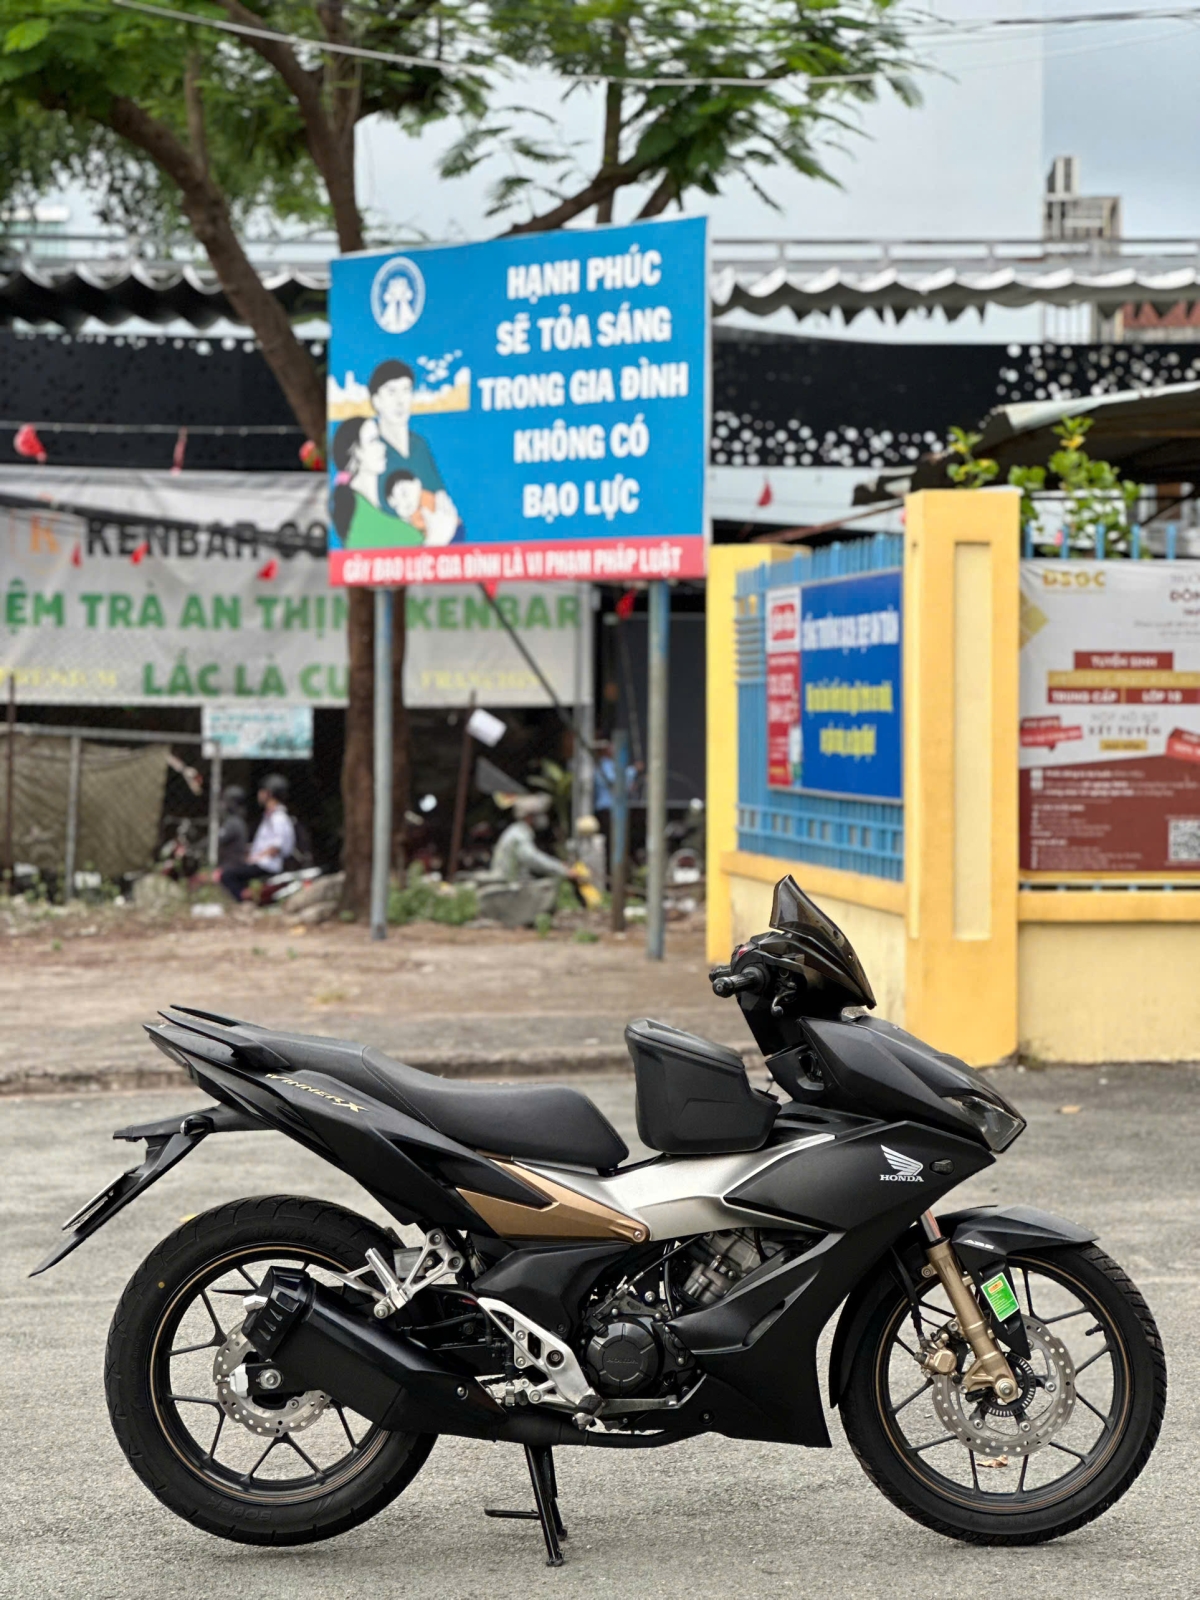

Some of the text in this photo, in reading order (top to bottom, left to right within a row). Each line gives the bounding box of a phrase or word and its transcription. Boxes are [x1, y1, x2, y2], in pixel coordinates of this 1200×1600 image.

[507, 243, 662, 304] HẠNH PHÚC
[496, 302, 673, 355] SẼ TỎA SÁNG
[477, 356, 689, 411] TRONG GIA ĐÌNH
[514, 413, 649, 464] KHÔNG CÓ
[523, 474, 640, 523] BẠO LỰC
[502, 546, 525, 578] LÀ
[593, 542, 638, 575] PHÁP
[638, 541, 682, 577] LUẬT
[180, 593, 241, 629] AN
[880, 1174, 924, 1182] HONDA
